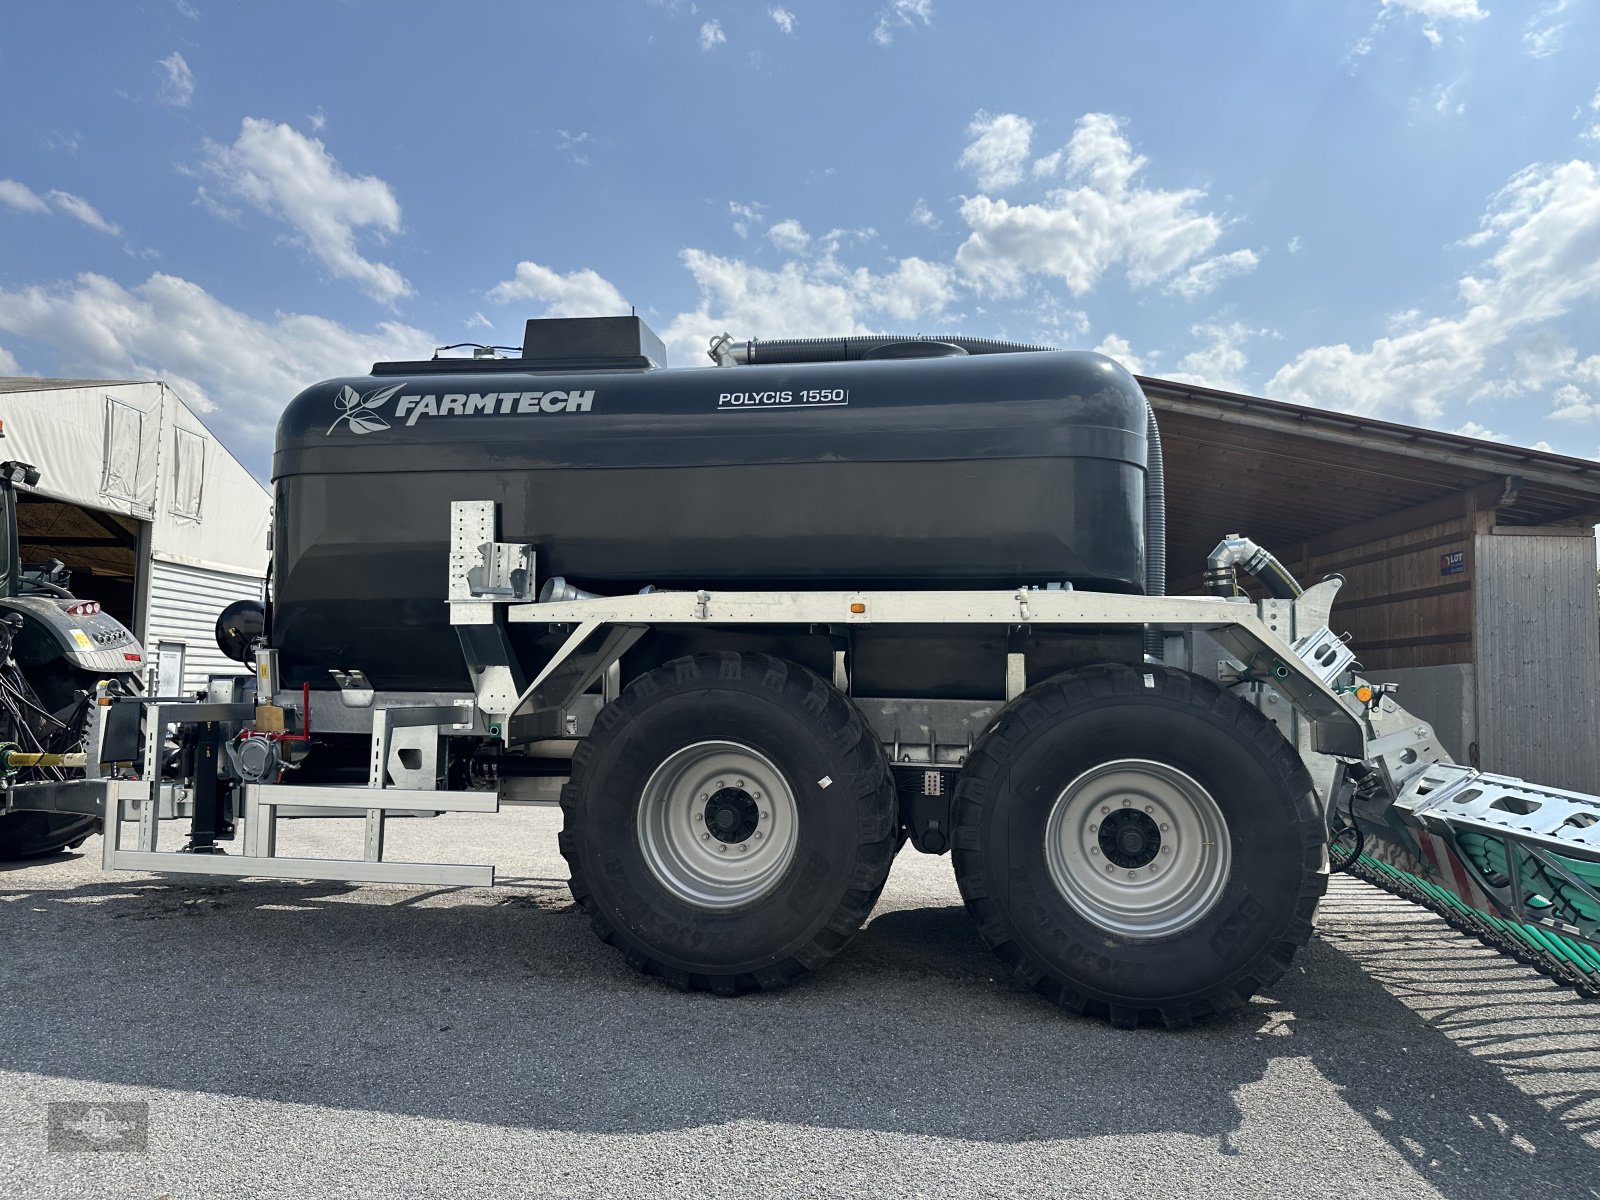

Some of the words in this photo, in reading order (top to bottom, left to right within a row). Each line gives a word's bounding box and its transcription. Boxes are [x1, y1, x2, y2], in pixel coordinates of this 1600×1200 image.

[395, 390, 595, 427] FARMTECH
[718, 391, 793, 405] POLYCIS
[799, 389, 844, 402] 1550
